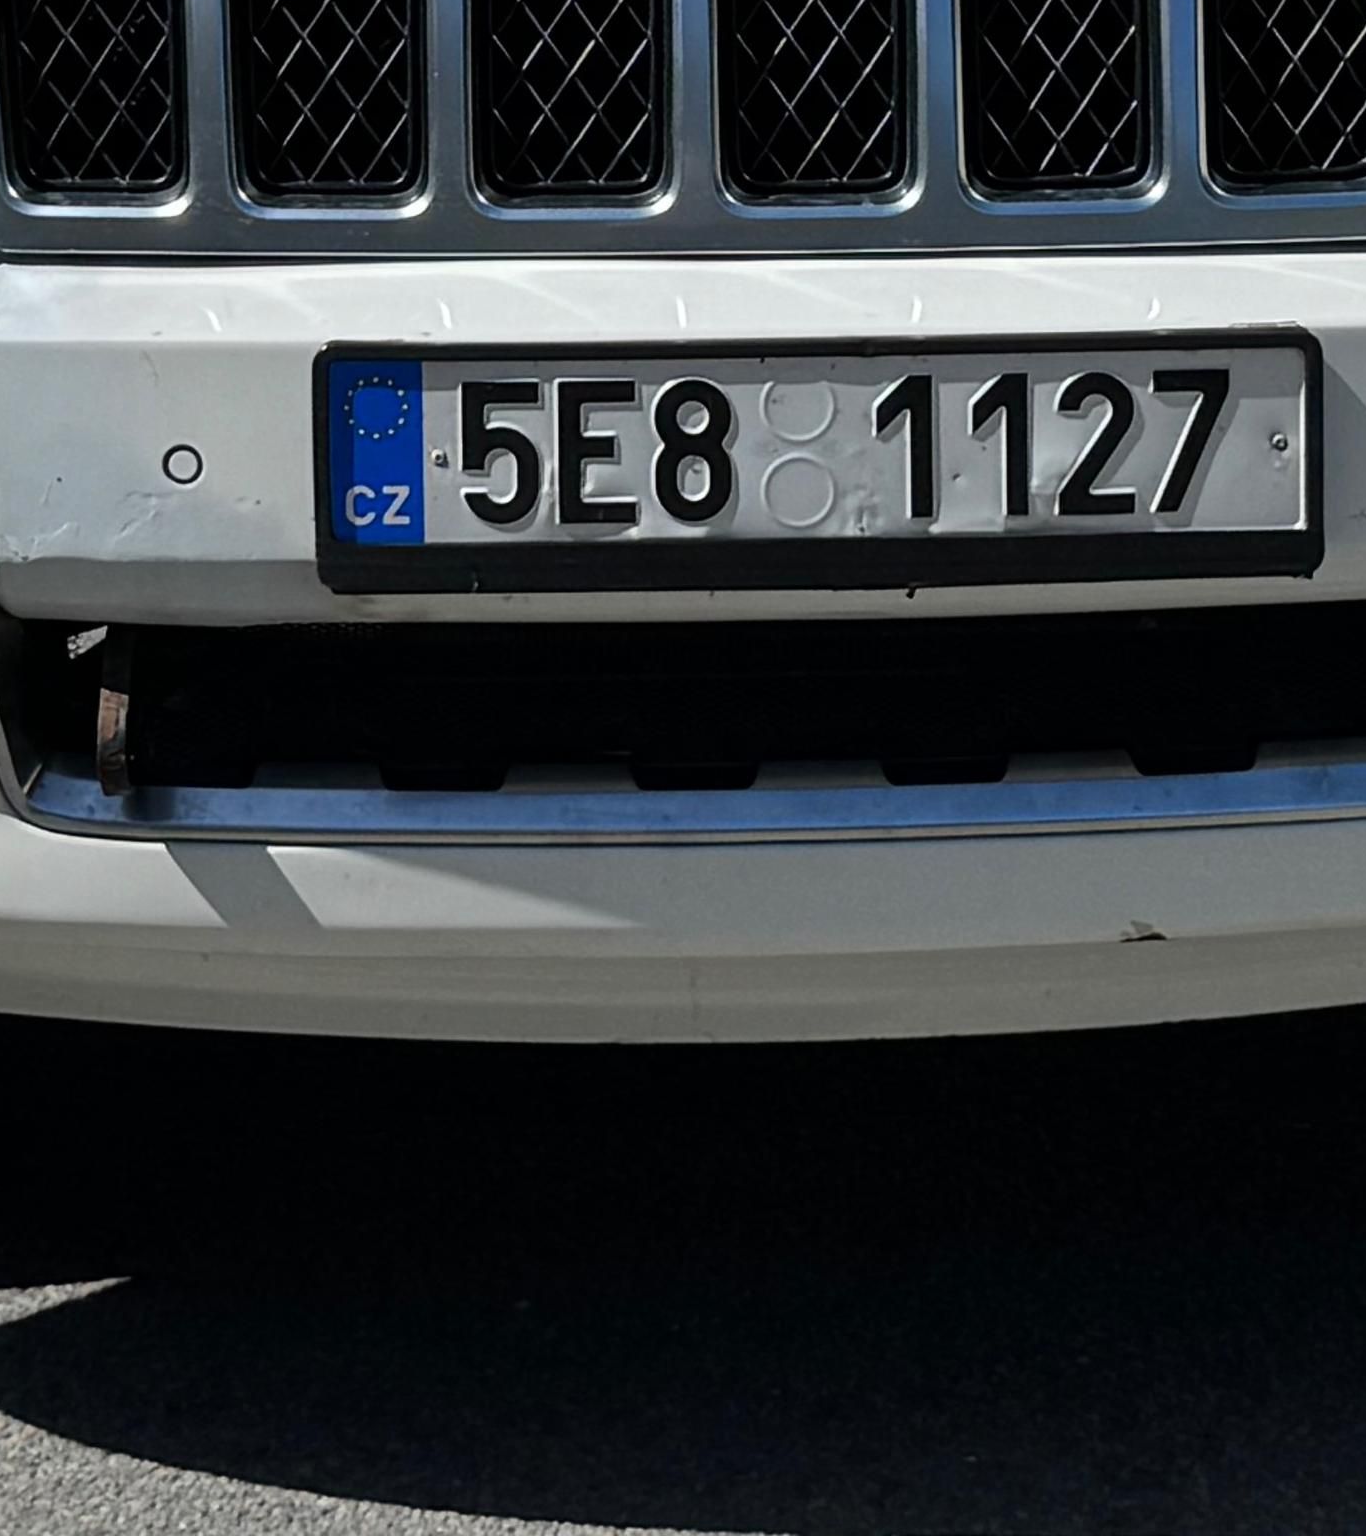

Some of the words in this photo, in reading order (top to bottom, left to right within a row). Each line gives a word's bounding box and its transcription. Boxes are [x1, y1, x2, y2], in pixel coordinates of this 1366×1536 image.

[460, 377, 733, 524] 5E8
[873, 369, 1231, 517] 1127
[345, 485, 411, 526] CZ
